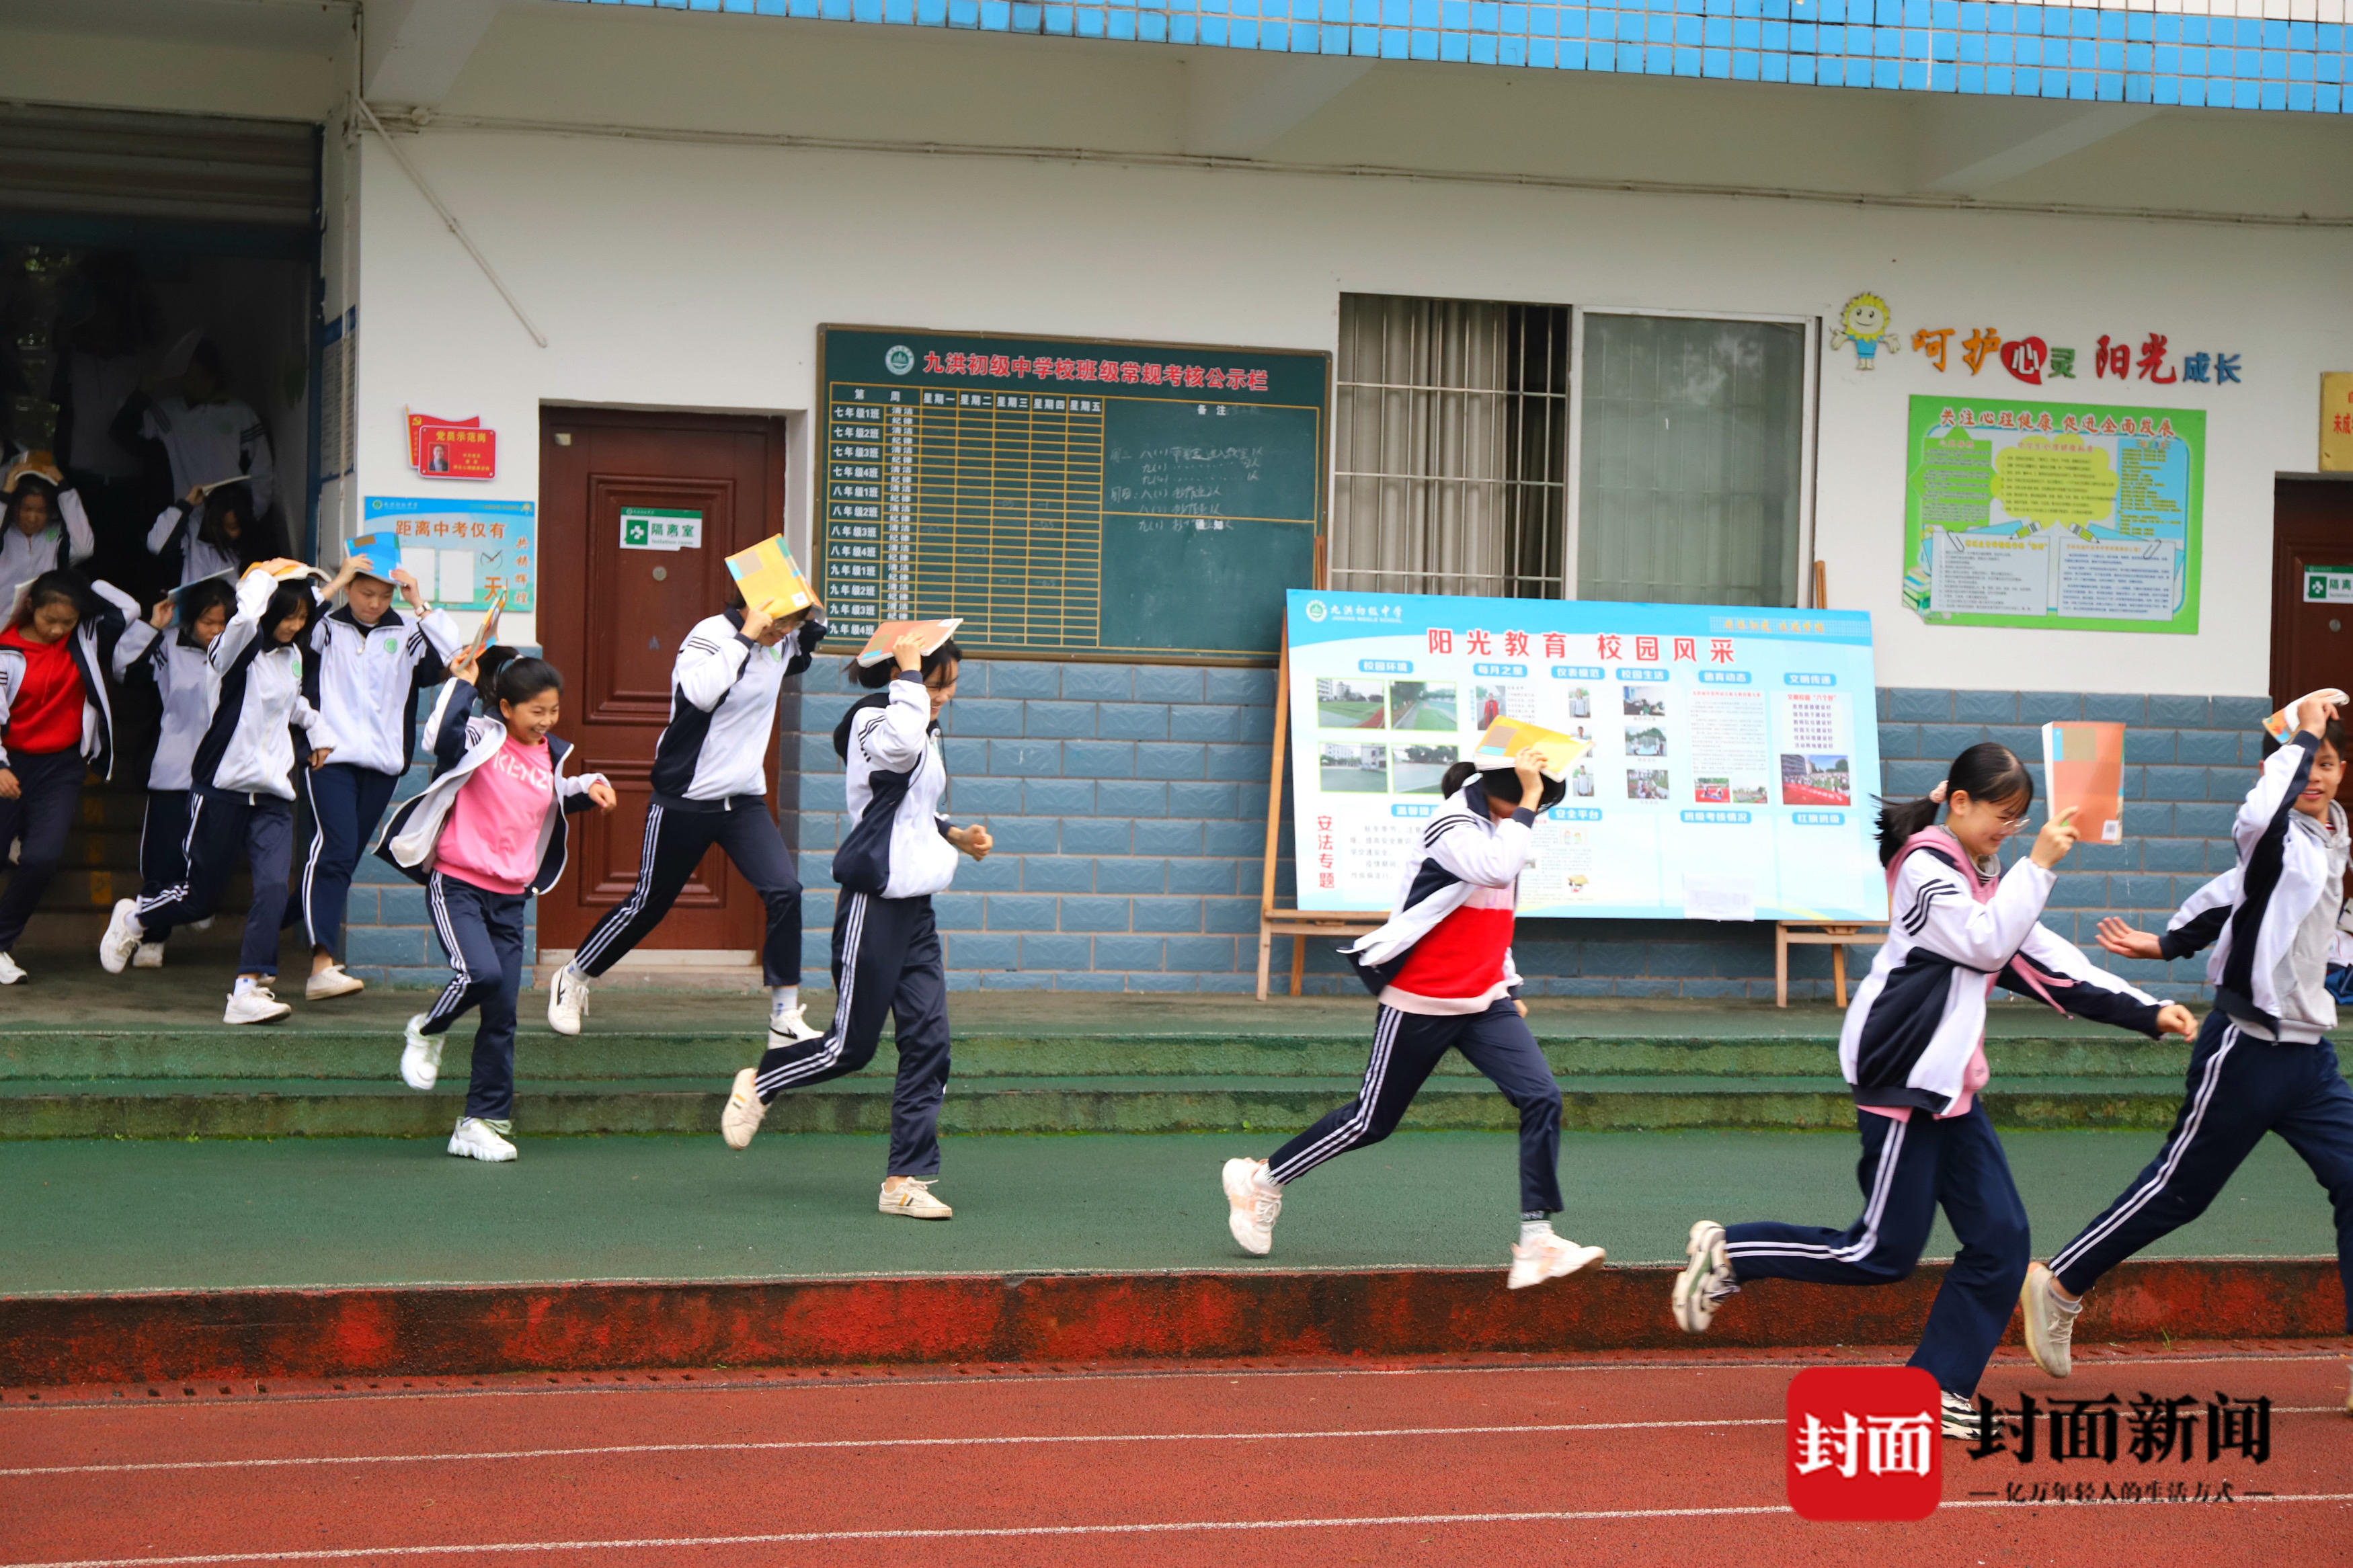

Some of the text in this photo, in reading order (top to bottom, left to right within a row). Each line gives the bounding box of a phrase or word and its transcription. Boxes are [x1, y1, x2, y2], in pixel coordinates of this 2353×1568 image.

[1911, 327, 2241, 385] 呵护心灵 阳光成长
[923, 350, 1269, 392] 九洪初级中学校班级常规考核公示栏
[854, 388, 900, 402] 第 周
[923, 393, 955, 405] 星期一
[959, 393, 993, 407] 星期二
[996, 396, 1029, 409] 星期三
[1033, 397, 1066, 411] 星期四
[1069, 399, 1101, 413] 星期五
[834, 407, 880, 419] 七年级1班
[1940, 408, 2174, 437] 关注心理健康 促进全面发展
[2332, 411, 2353, 436] 未成
[834, 427, 879, 439] 七年级2班
[833, 446, 879, 458] 七年级3班
[833, 466, 878, 478] 七年级4班
[832, 486, 878, 497] 八年级1班
[832, 505, 878, 518] 八年级2班
[396, 520, 506, 539] 距离中考仅有
[651, 523, 694, 537] 隔离室
[831, 526, 877, 538] 八年级3班
[830, 545, 876, 557] 八年级4班
[830, 564, 876, 577] 九年级1班
[830, 583, 875, 596] 九年级2班
[830, 603, 875, 616] 九年级3班
[829, 623, 875, 636] 九年级4班
[1428, 629, 1735, 664] 阳光教育 校园风采
[1363, 661, 1408, 672] 校园环境
[1477, 664, 1524, 676] 每月之星
[1621, 669, 1665, 679] 校园生活
[1396, 805, 1432, 817] 温馨提
[1555, 809, 1599, 820] 安全平台
[1684, 811, 1748, 823] 班级考核情况
[1797, 813, 1840, 824] 红旗班级
[1317, 815, 1335, 889] 安法专题
